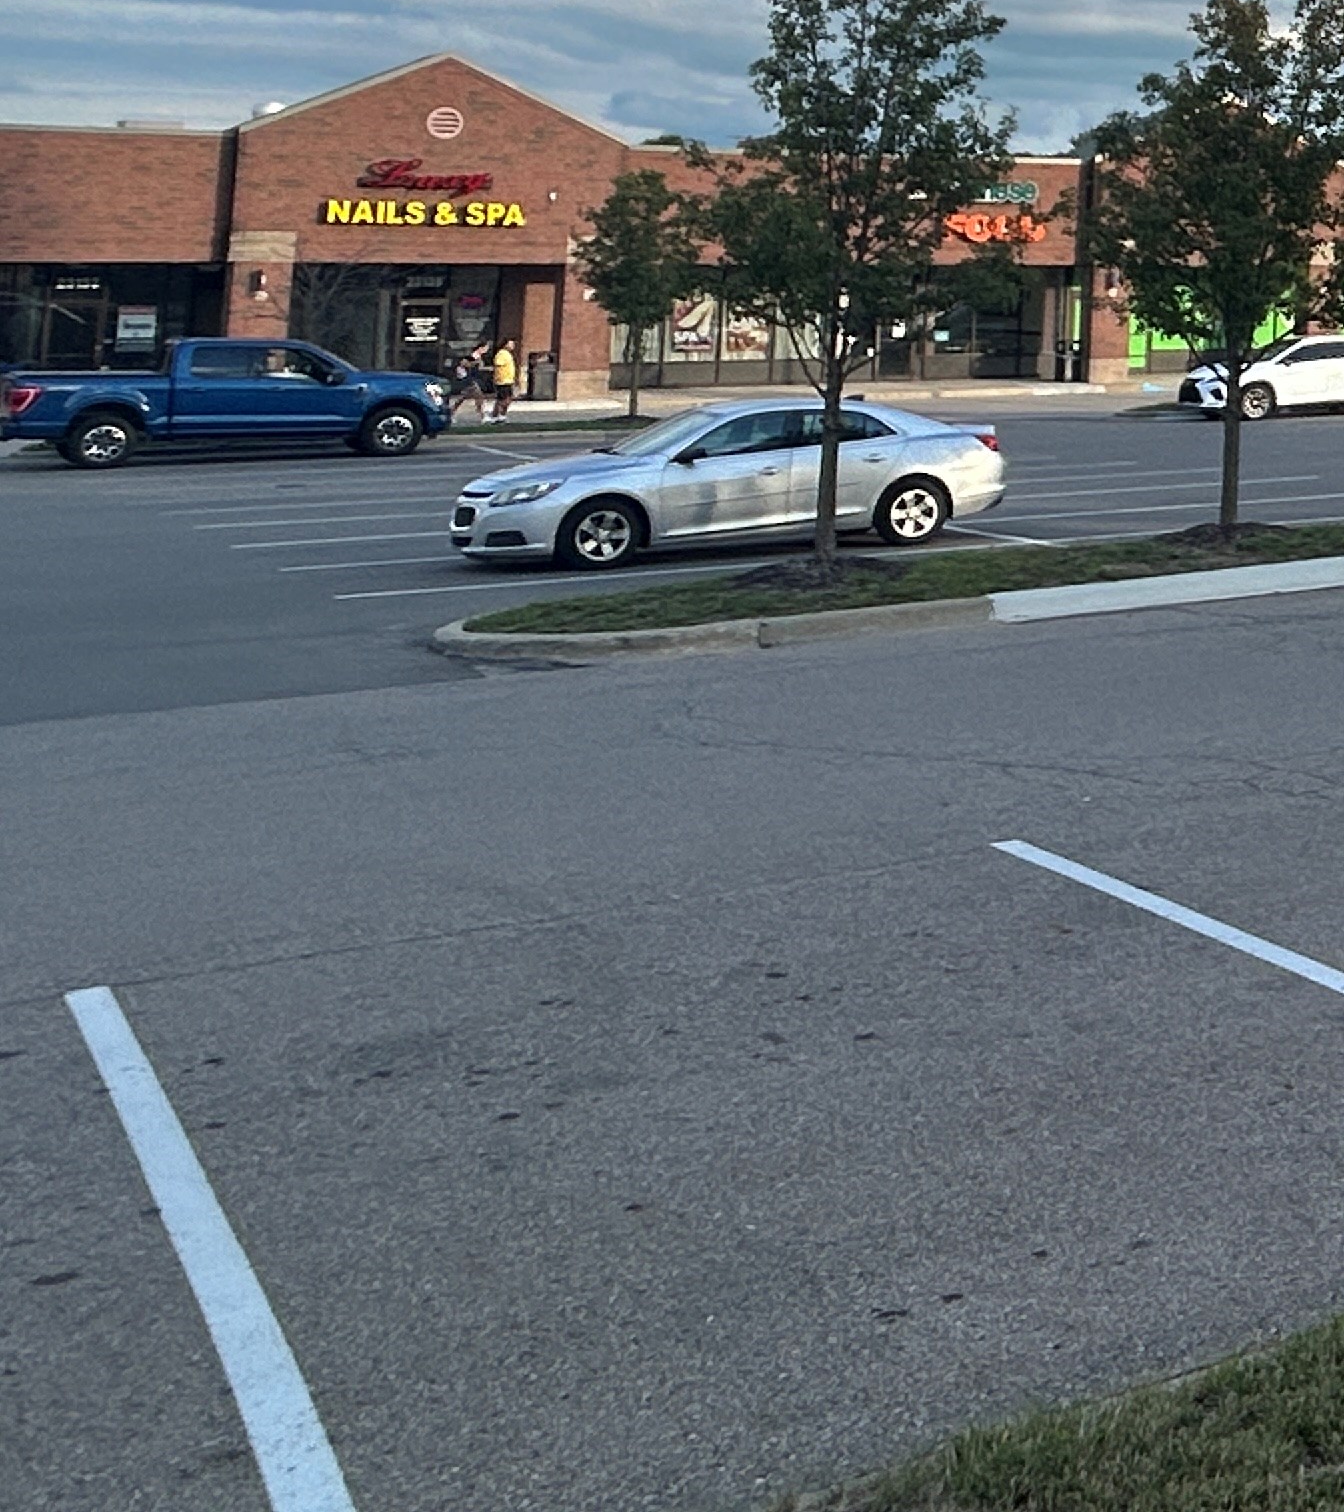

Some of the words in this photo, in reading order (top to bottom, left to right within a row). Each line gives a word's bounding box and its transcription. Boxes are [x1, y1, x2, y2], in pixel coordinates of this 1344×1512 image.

[325, 199, 426, 225] NAILS
[434, 201, 458, 226] &
[465, 202, 528, 227] SPA
